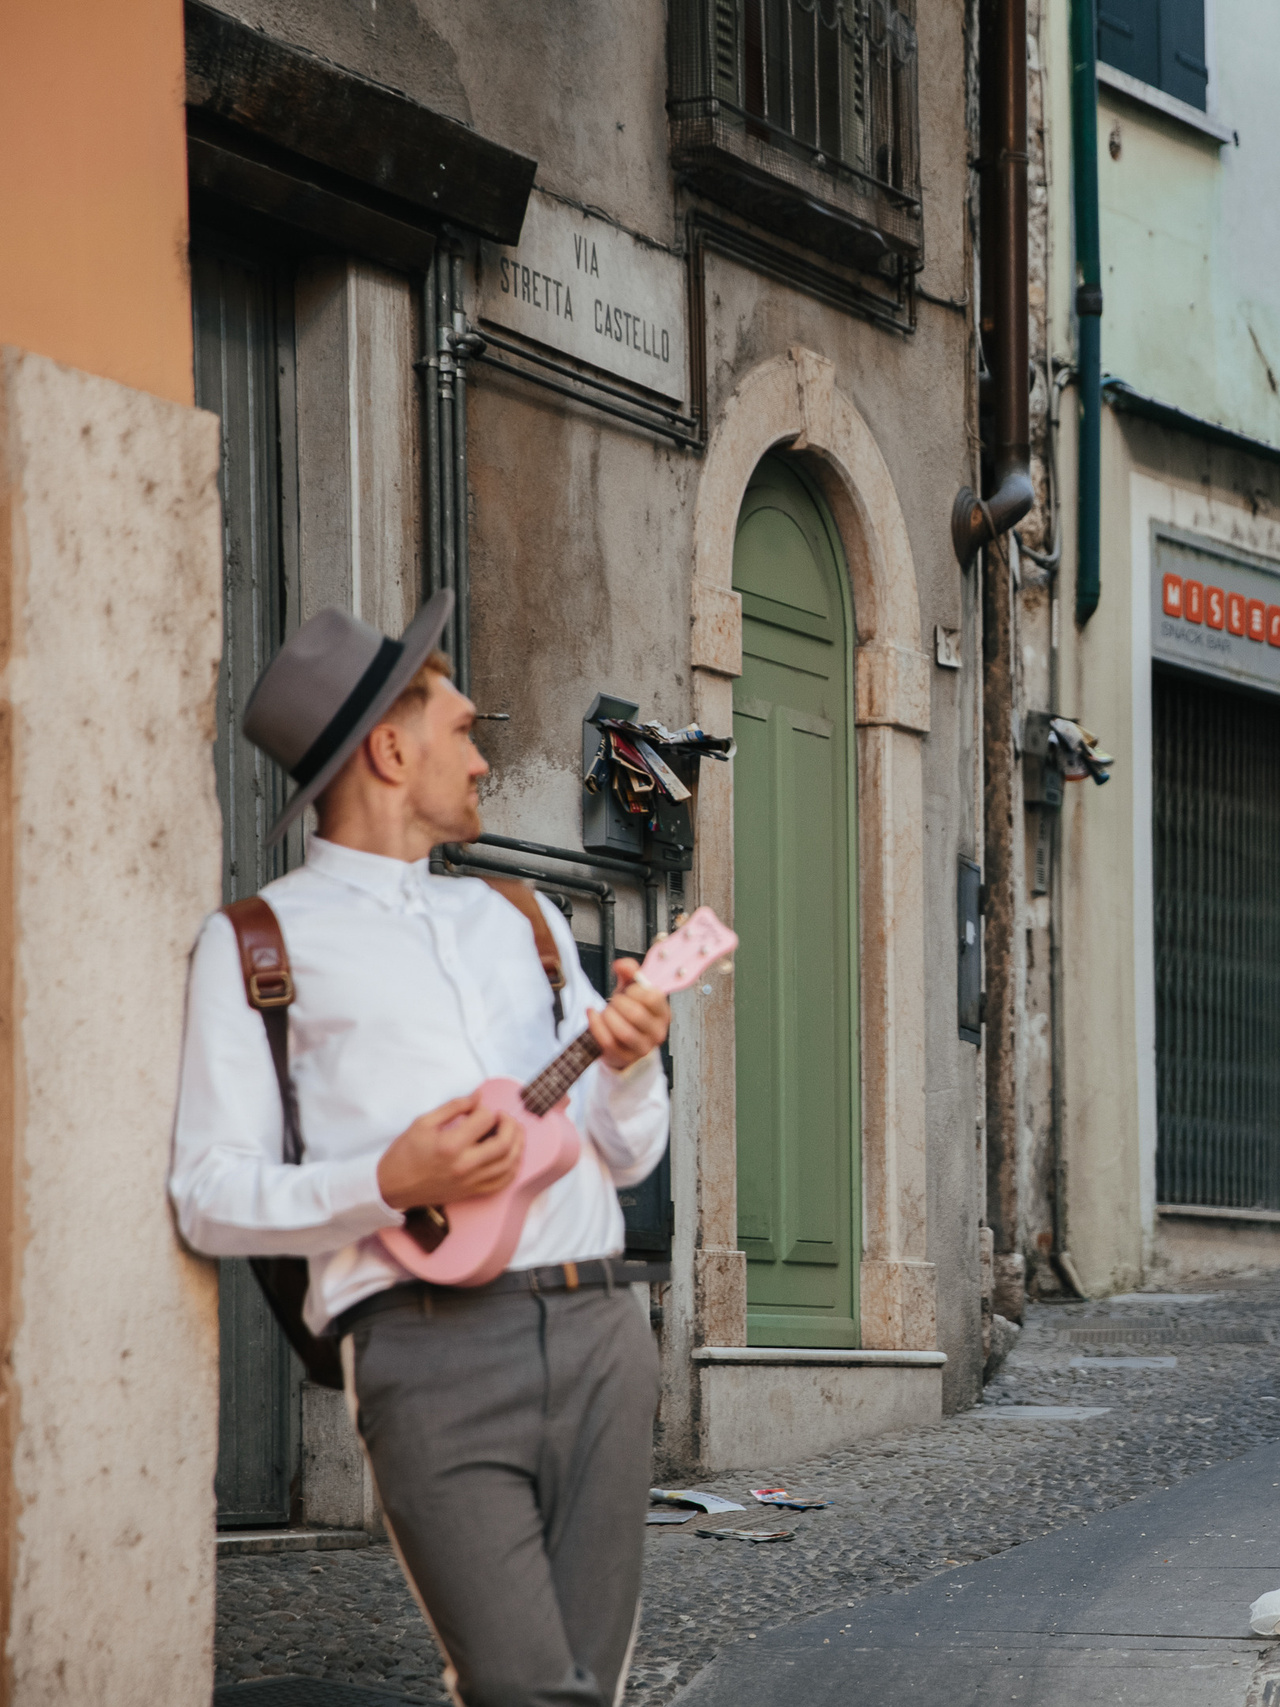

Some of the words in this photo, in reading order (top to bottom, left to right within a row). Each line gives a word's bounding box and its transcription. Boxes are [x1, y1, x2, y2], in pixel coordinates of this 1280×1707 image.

[573, 233, 600, 279] VIA
[500, 256, 574, 322] STRETTA
[593, 299, 670, 363] CASTELLO
[1161, 620, 1204, 645] SNACK
[1206, 633, 1232, 652] BAR
